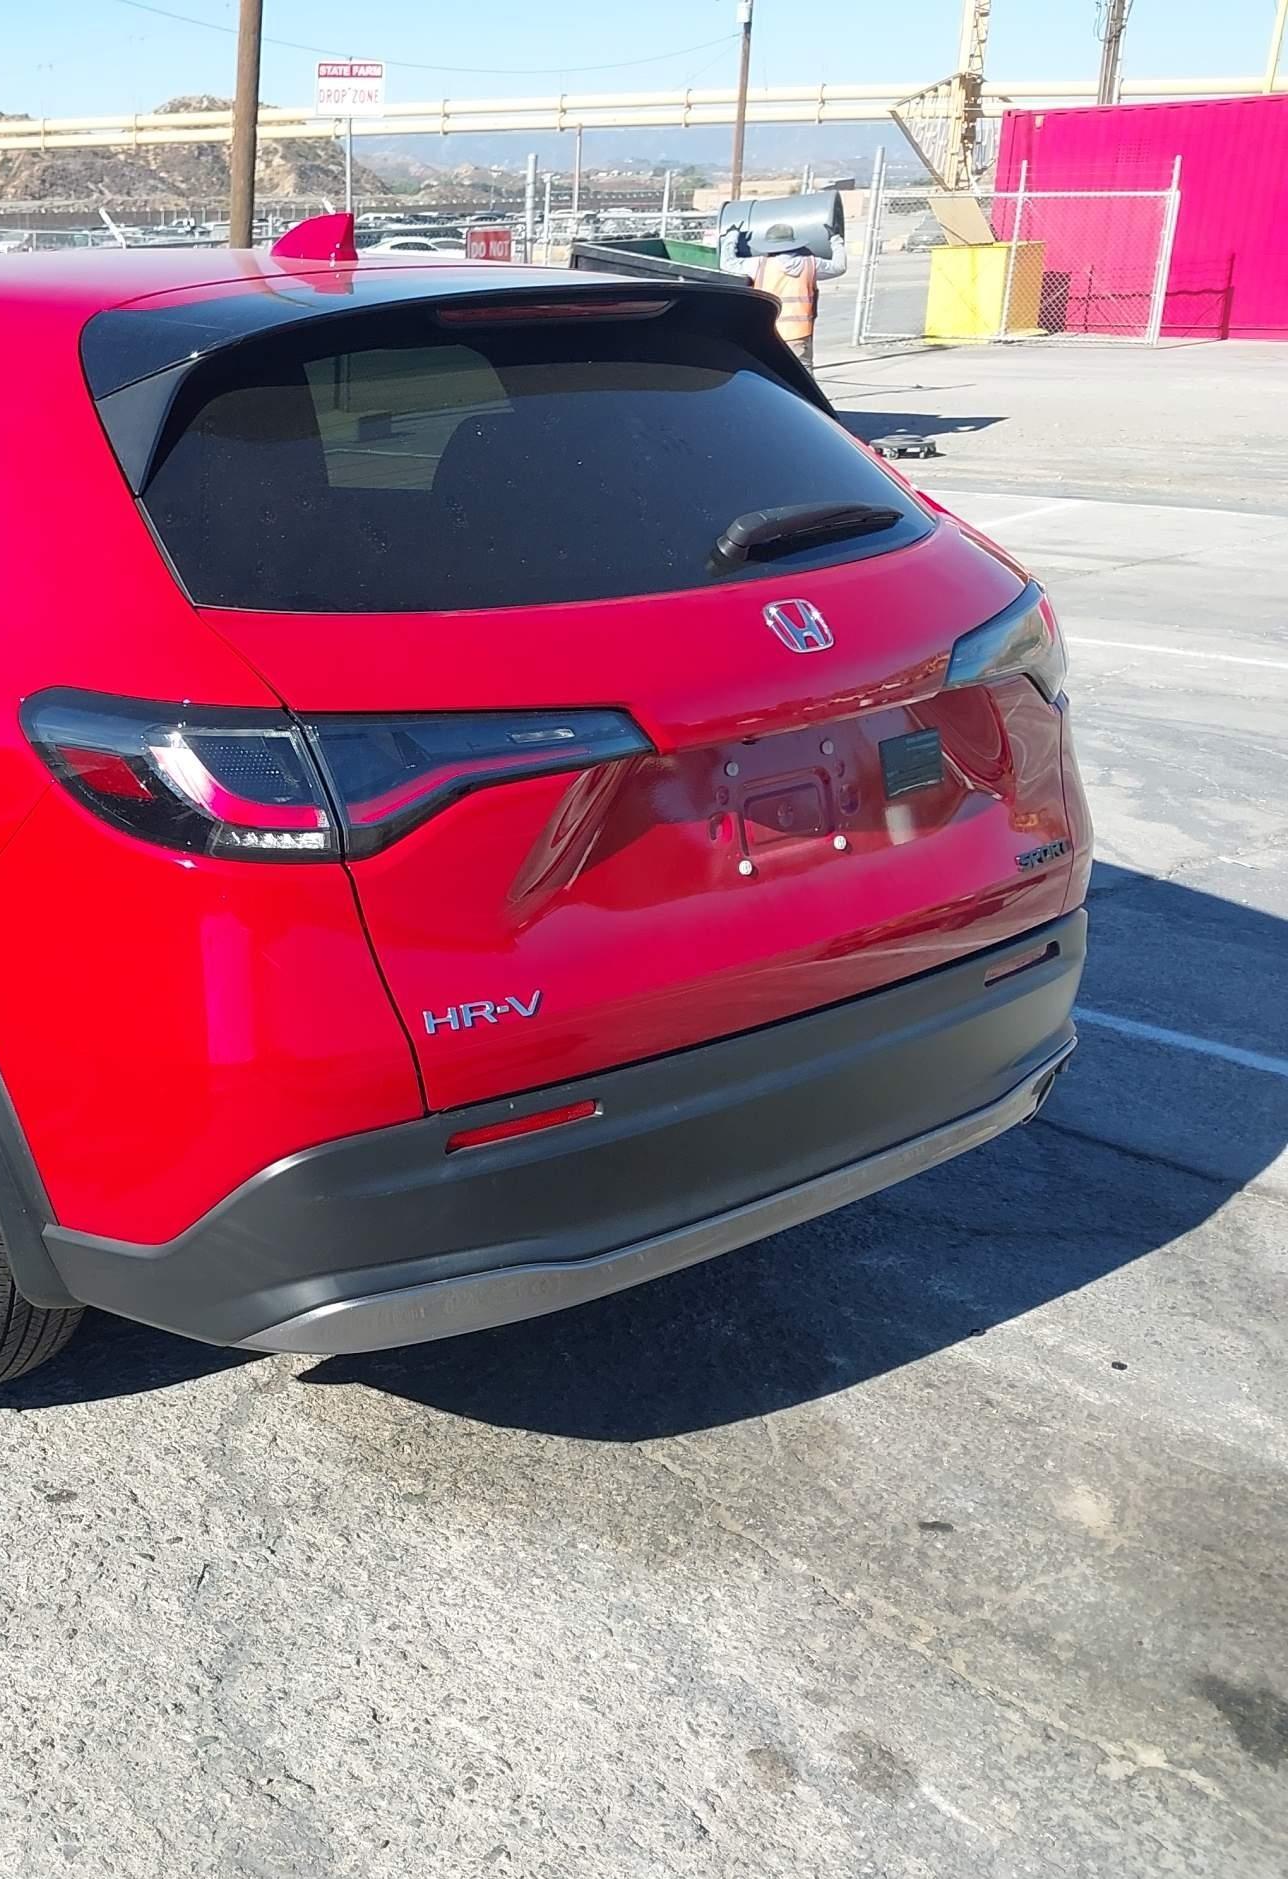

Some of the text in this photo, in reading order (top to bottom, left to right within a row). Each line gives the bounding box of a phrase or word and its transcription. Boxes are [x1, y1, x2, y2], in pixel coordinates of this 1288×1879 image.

[319, 65, 382, 77] STATE FARM
[319, 89, 379, 104] DROP ZONE
[471, 240, 511, 258] DO NOT
[1015, 839, 1070, 870] SPORT
[422, 990, 541, 1034] HR-V
